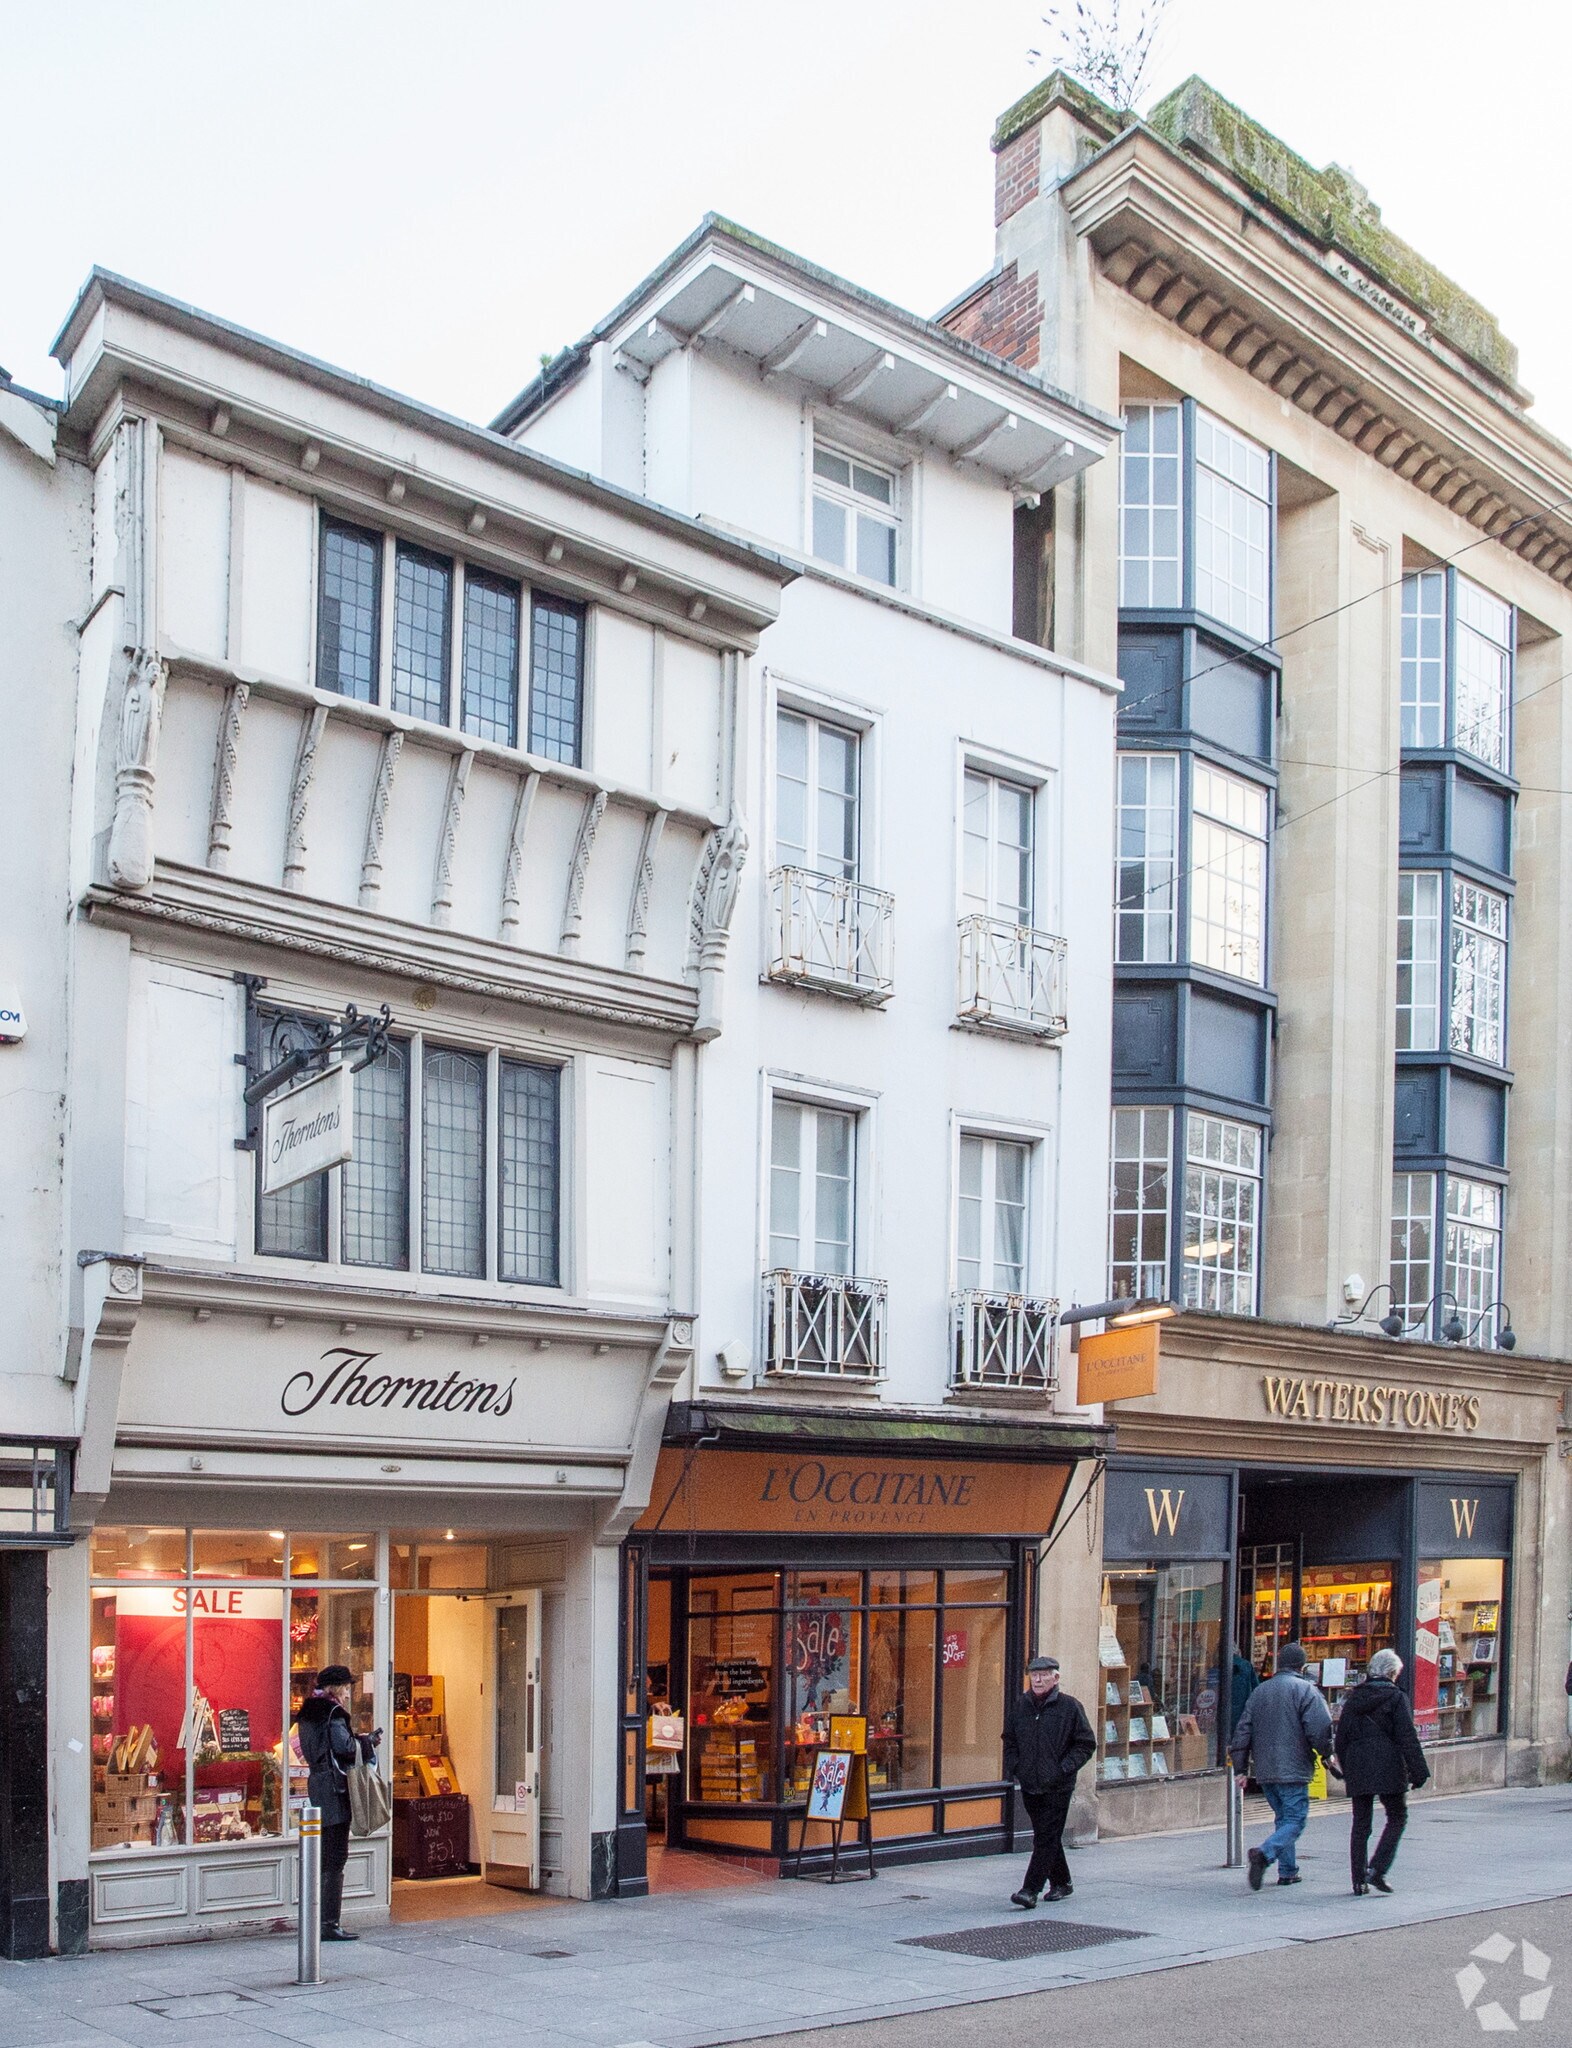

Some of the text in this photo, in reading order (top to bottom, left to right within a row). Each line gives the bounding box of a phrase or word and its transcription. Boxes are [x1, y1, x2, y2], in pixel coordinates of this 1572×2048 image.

[272, 1104, 340, 1164] Thorntons
[281, 1347, 517, 1416] Thorntons
[1264, 1376, 1480, 1431] WATERSTONE'S
[758, 1461, 976, 1506] L'OCCITANE
[793, 1510, 928, 1524] EN PROVENCE
[1144, 1488, 1185, 1536] W
[1450, 1499, 1479, 1539] W
[172, 1587, 243, 1613] SALE
[796, 1612, 840, 1670] Sale
[953, 1650, 966, 1661] OFF
[818, 1760, 844, 1790] Sale
